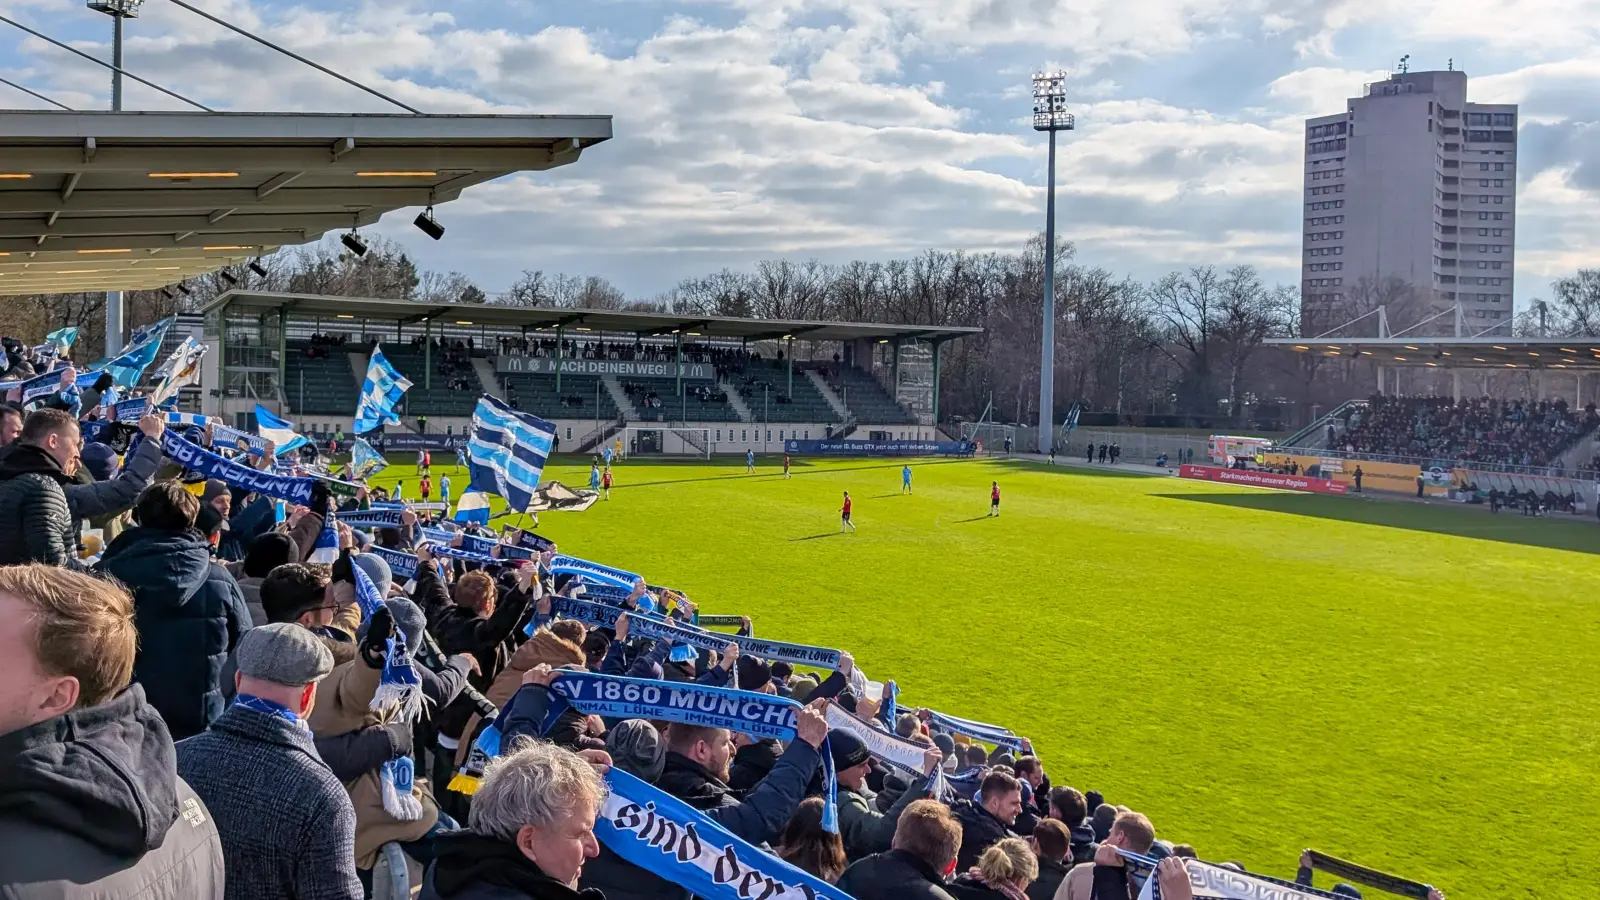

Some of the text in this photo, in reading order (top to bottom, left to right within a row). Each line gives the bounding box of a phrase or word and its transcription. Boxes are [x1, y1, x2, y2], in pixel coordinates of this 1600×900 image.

[549, 361, 667, 375] MACH DEINEN WEG!
[1219, 471, 1308, 488] Starkmacherin unserer Region
[386, 554, 404, 567] 1860
[777, 646, 807, 659] IMMER
[551, 679, 584, 699] SV
[592, 680, 661, 704] 1860
[624, 703, 665, 717] LÖWE
[685, 712, 734, 728] IMMER
[741, 722, 783, 737] LÖWE
[612, 801, 786, 900] sind der
